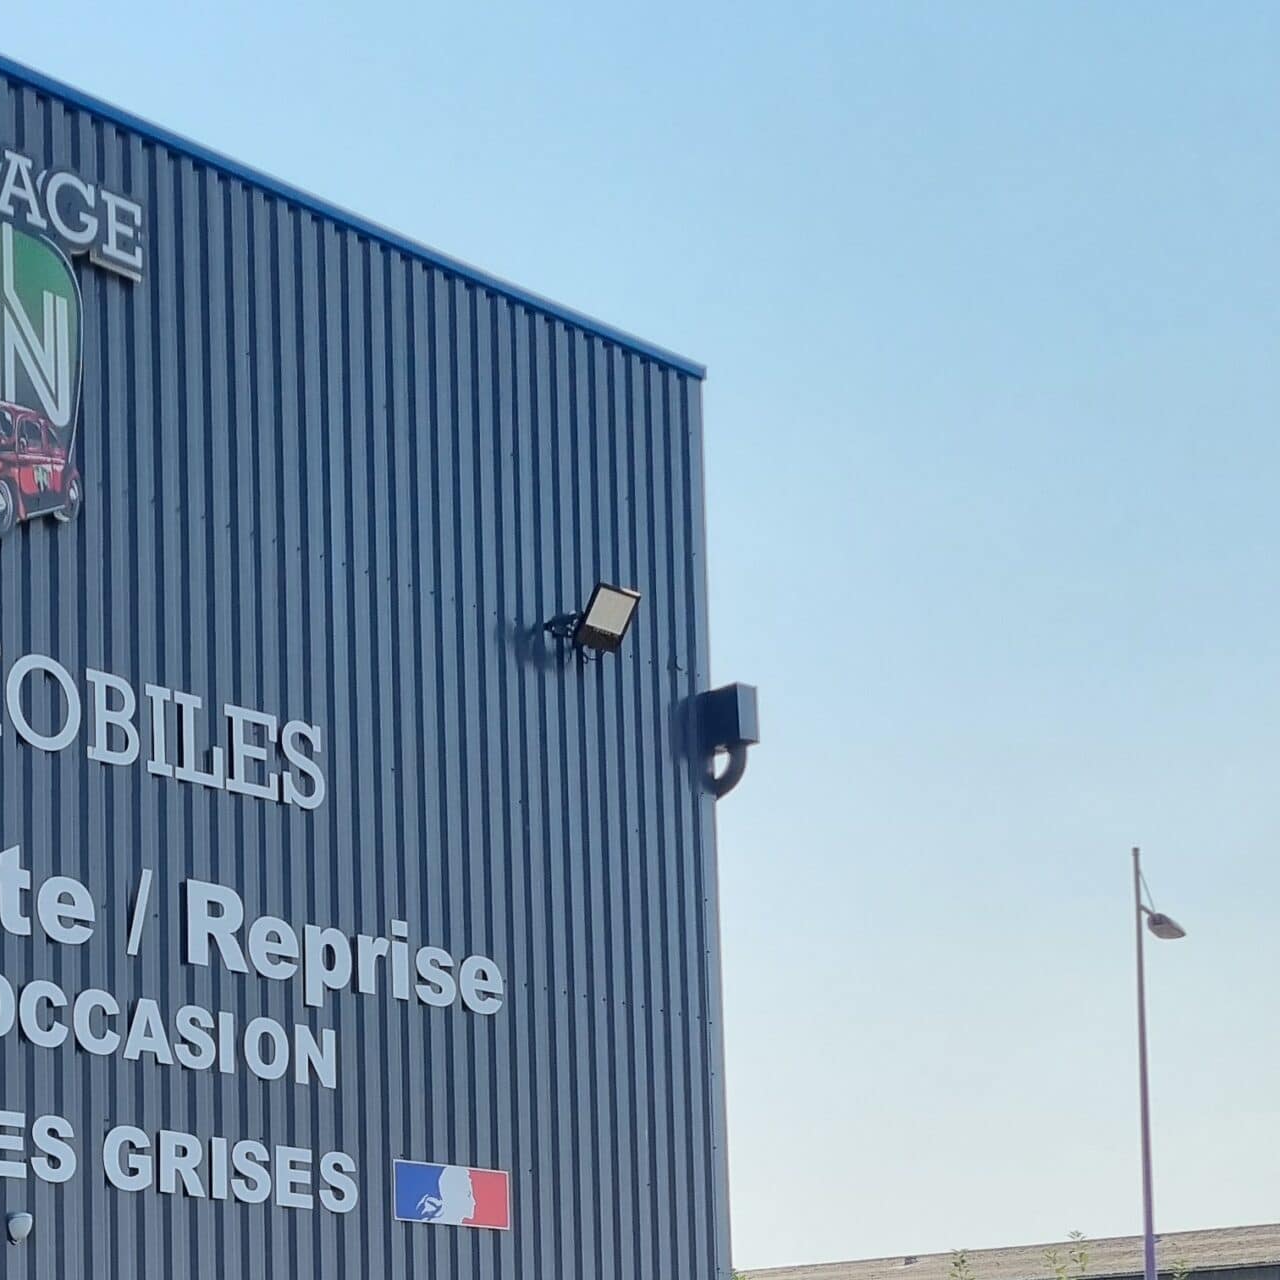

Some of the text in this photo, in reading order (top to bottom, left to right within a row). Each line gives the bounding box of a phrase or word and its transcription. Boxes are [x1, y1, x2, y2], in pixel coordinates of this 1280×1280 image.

[127, 868, 153, 956] /
[186, 878, 504, 1016] Reprise
[102, 1125, 359, 1214] GRISES
